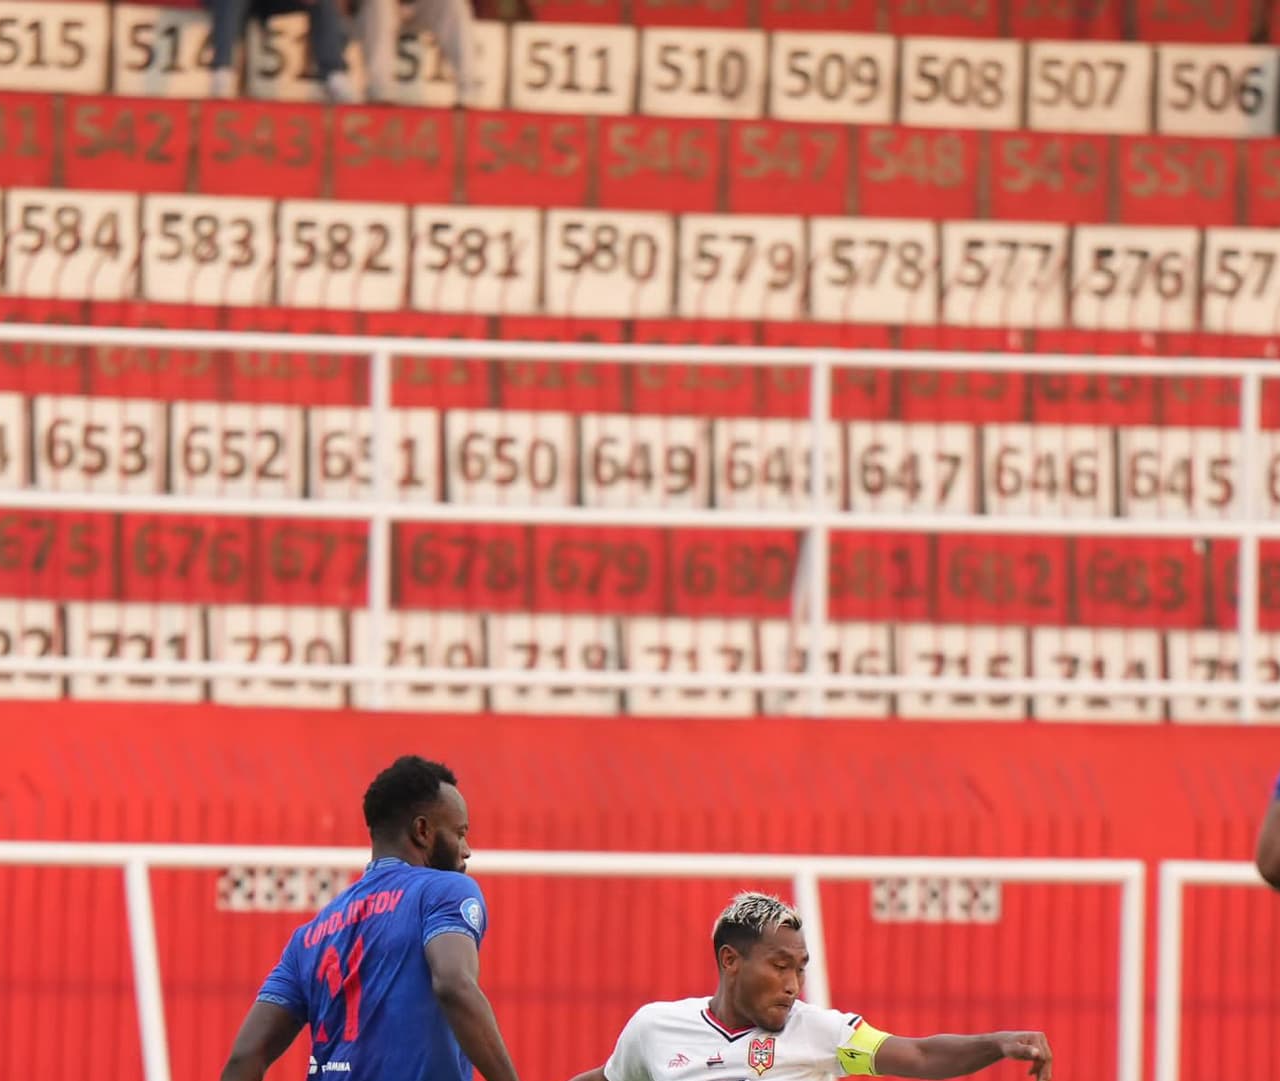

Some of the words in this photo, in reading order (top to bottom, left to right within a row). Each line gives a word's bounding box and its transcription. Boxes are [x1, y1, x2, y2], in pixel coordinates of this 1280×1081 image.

[525, 41, 613, 94] 511
[656, 45, 748, 100] 510
[785, 50, 880, 104] 509
[914, 54, 1005, 109] 508
[1038, 58, 1127, 110] 507
[1169, 61, 1265, 114] 506
[72, 106, 175, 164] 542
[214, 111, 314, 167] 543
[341, 112, 440, 168] 544
[478, 120, 580, 176] 545
[608, 122, 710, 180] 546
[738, 126, 839, 179] 547
[865, 131, 966, 186] 548
[1000, 140, 1100, 194] 549
[1126, 142, 1227, 199] 550
[18, 202, 121, 262] 584
[156, 212, 256, 269] 583
[292, 219, 392, 274] 582
[427, 222, 521, 281] 581
[560, 223, 658, 281] 580
[694, 234, 796, 291] 579
[827, 238, 926, 291] 578
[960, 240, 1053, 295] 577
[1092, 247, 1185, 301] 576
[45, 419, 150, 478] 653
[182, 426, 284, 481] 652
[458, 432, 558, 489] 650
[592, 436, 697, 494] 649
[860, 444, 963, 500] 647
[994, 446, 1099, 502] 646
[1128, 450, 1235, 509] 645
[132, 521, 243, 585] 676
[410, 532, 518, 590] 678
[546, 540, 650, 595] 679
